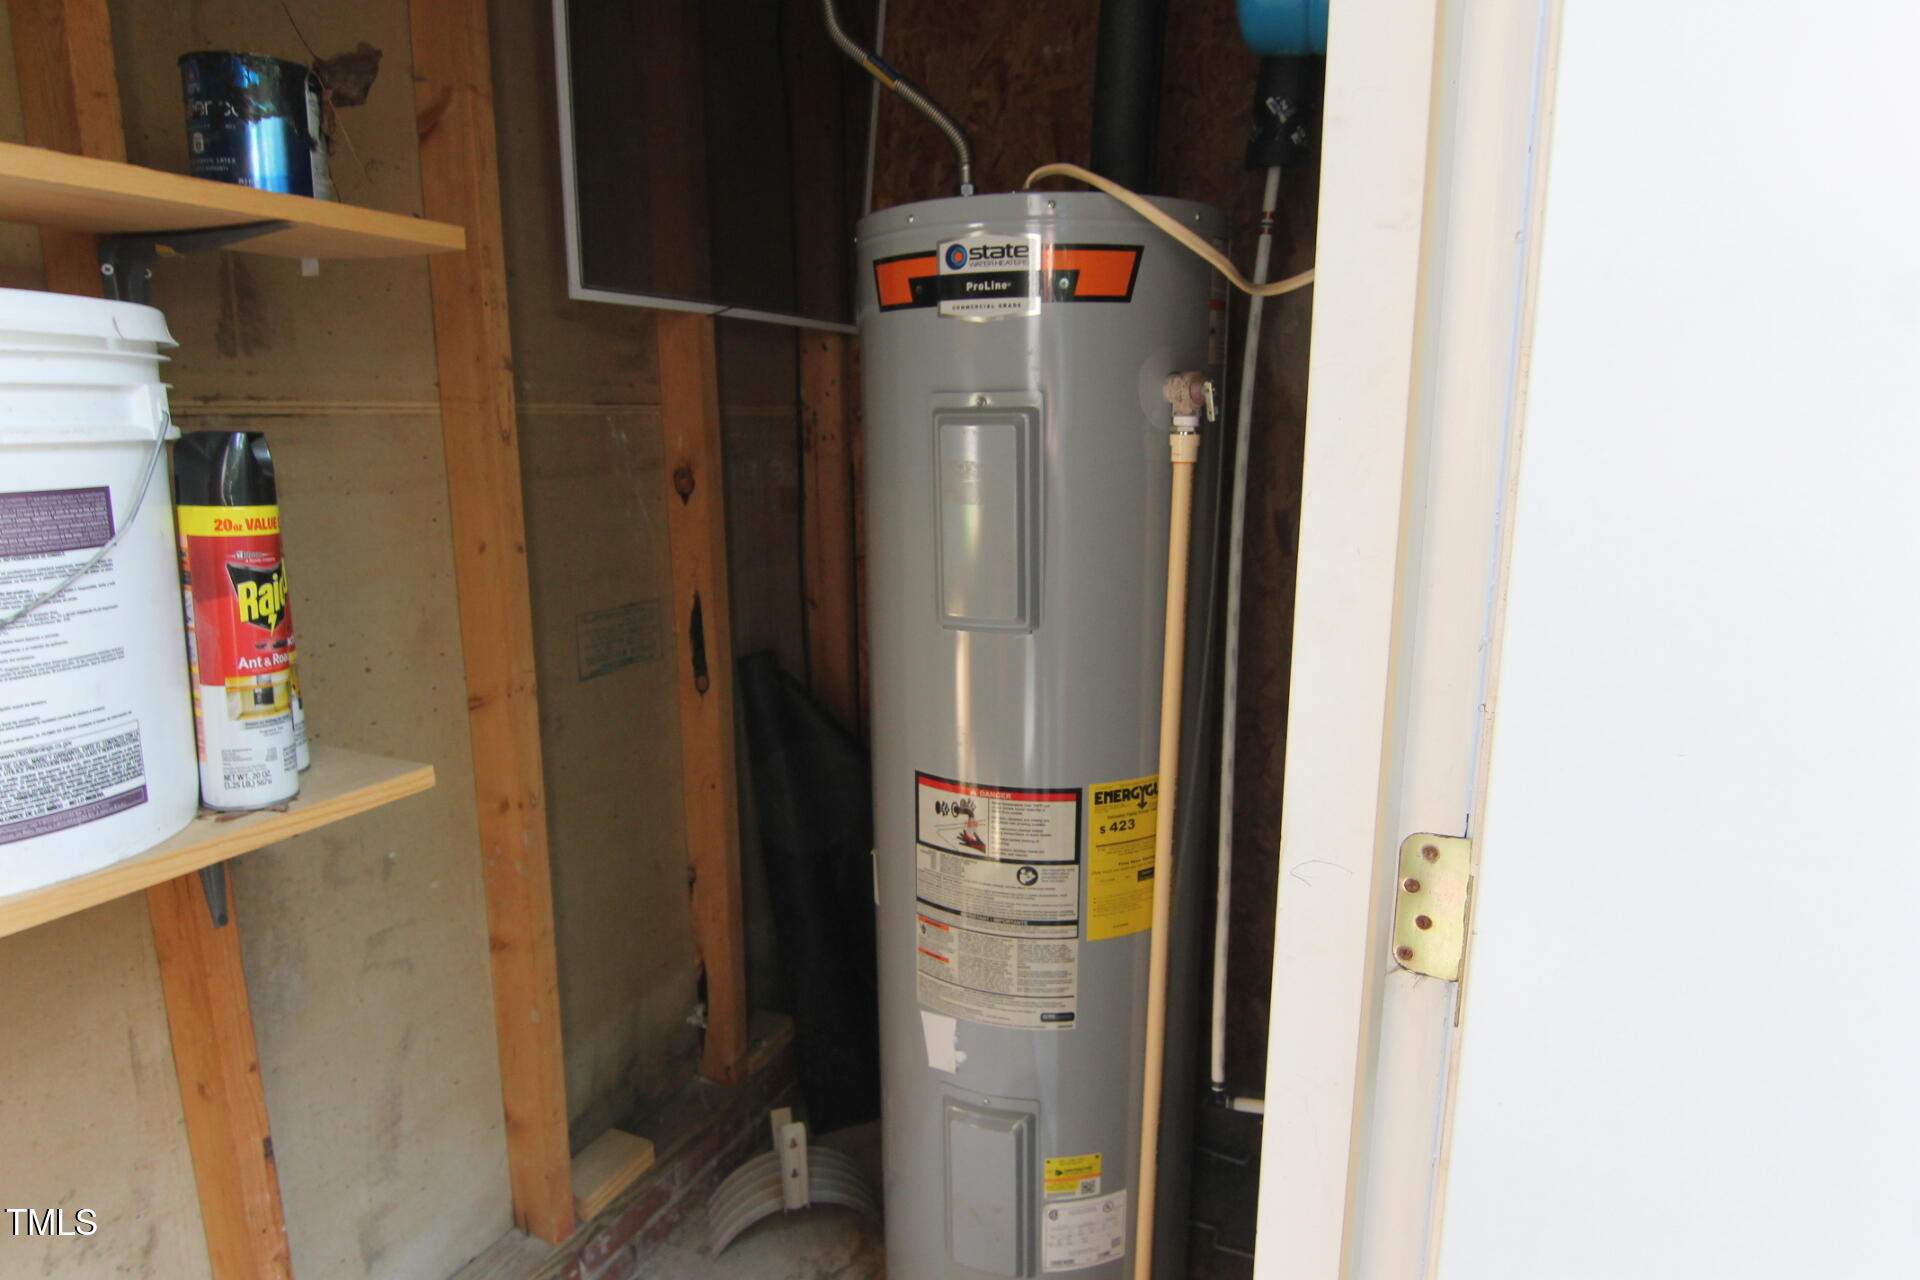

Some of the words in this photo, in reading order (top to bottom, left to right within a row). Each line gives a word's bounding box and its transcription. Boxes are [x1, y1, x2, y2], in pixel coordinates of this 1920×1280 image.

[968, 243, 1029, 260] state
[966, 281, 1007, 292] ProLine
[237, 560, 288, 623] Raid
[238, 654, 263, 670] Ant
[979, 790, 1012, 800] DANGER
[1109, 818, 1136, 833] 423
